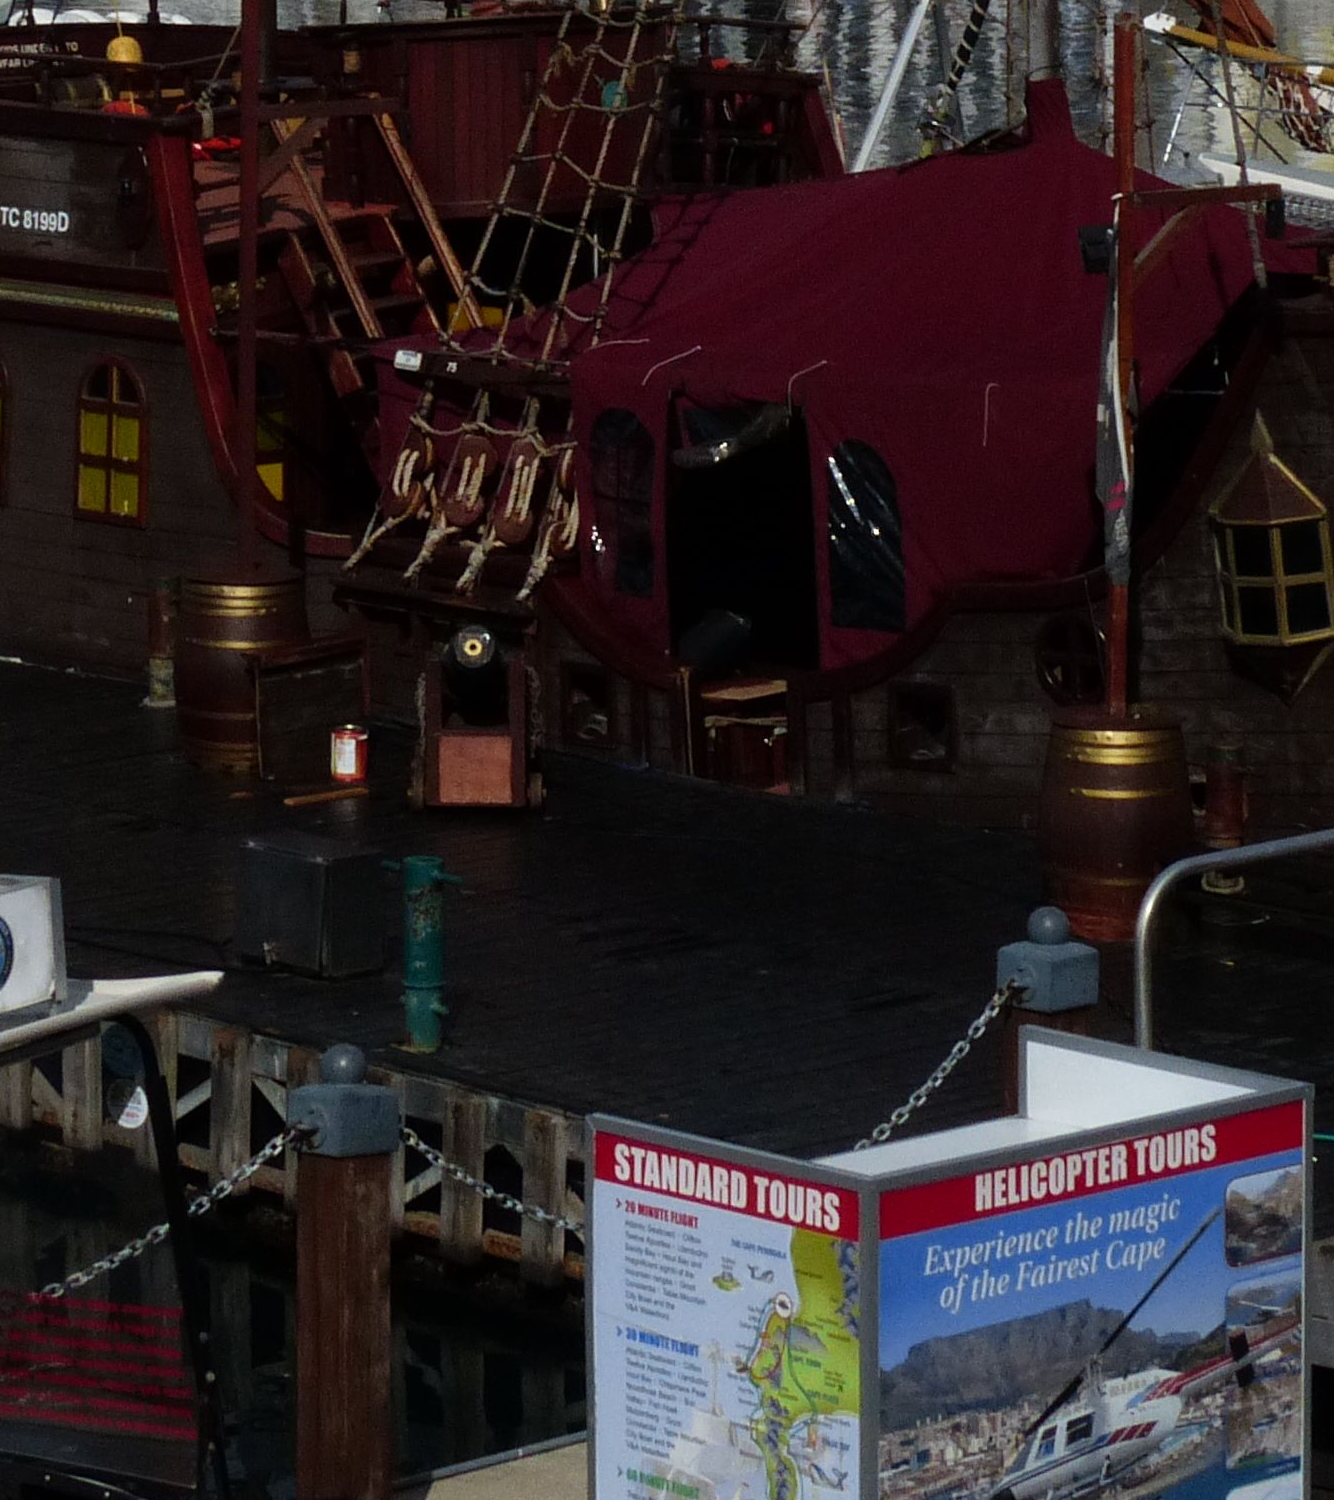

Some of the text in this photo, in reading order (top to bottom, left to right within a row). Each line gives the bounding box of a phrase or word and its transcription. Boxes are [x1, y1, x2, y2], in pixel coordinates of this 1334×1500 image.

[23, 211, 69, 232] 8199D
[614, 1143, 841, 1232] STANDARD TOURS
[975, 1124, 1217, 1213] HELICOPTER TOURS
[638, 1203, 669, 1222] MINUTE
[671, 1210, 699, 1229] FLIGHT
[924, 1194, 1181, 1279] Experience the magic
[939, 1236, 1166, 1316] of the Fairest Cape
